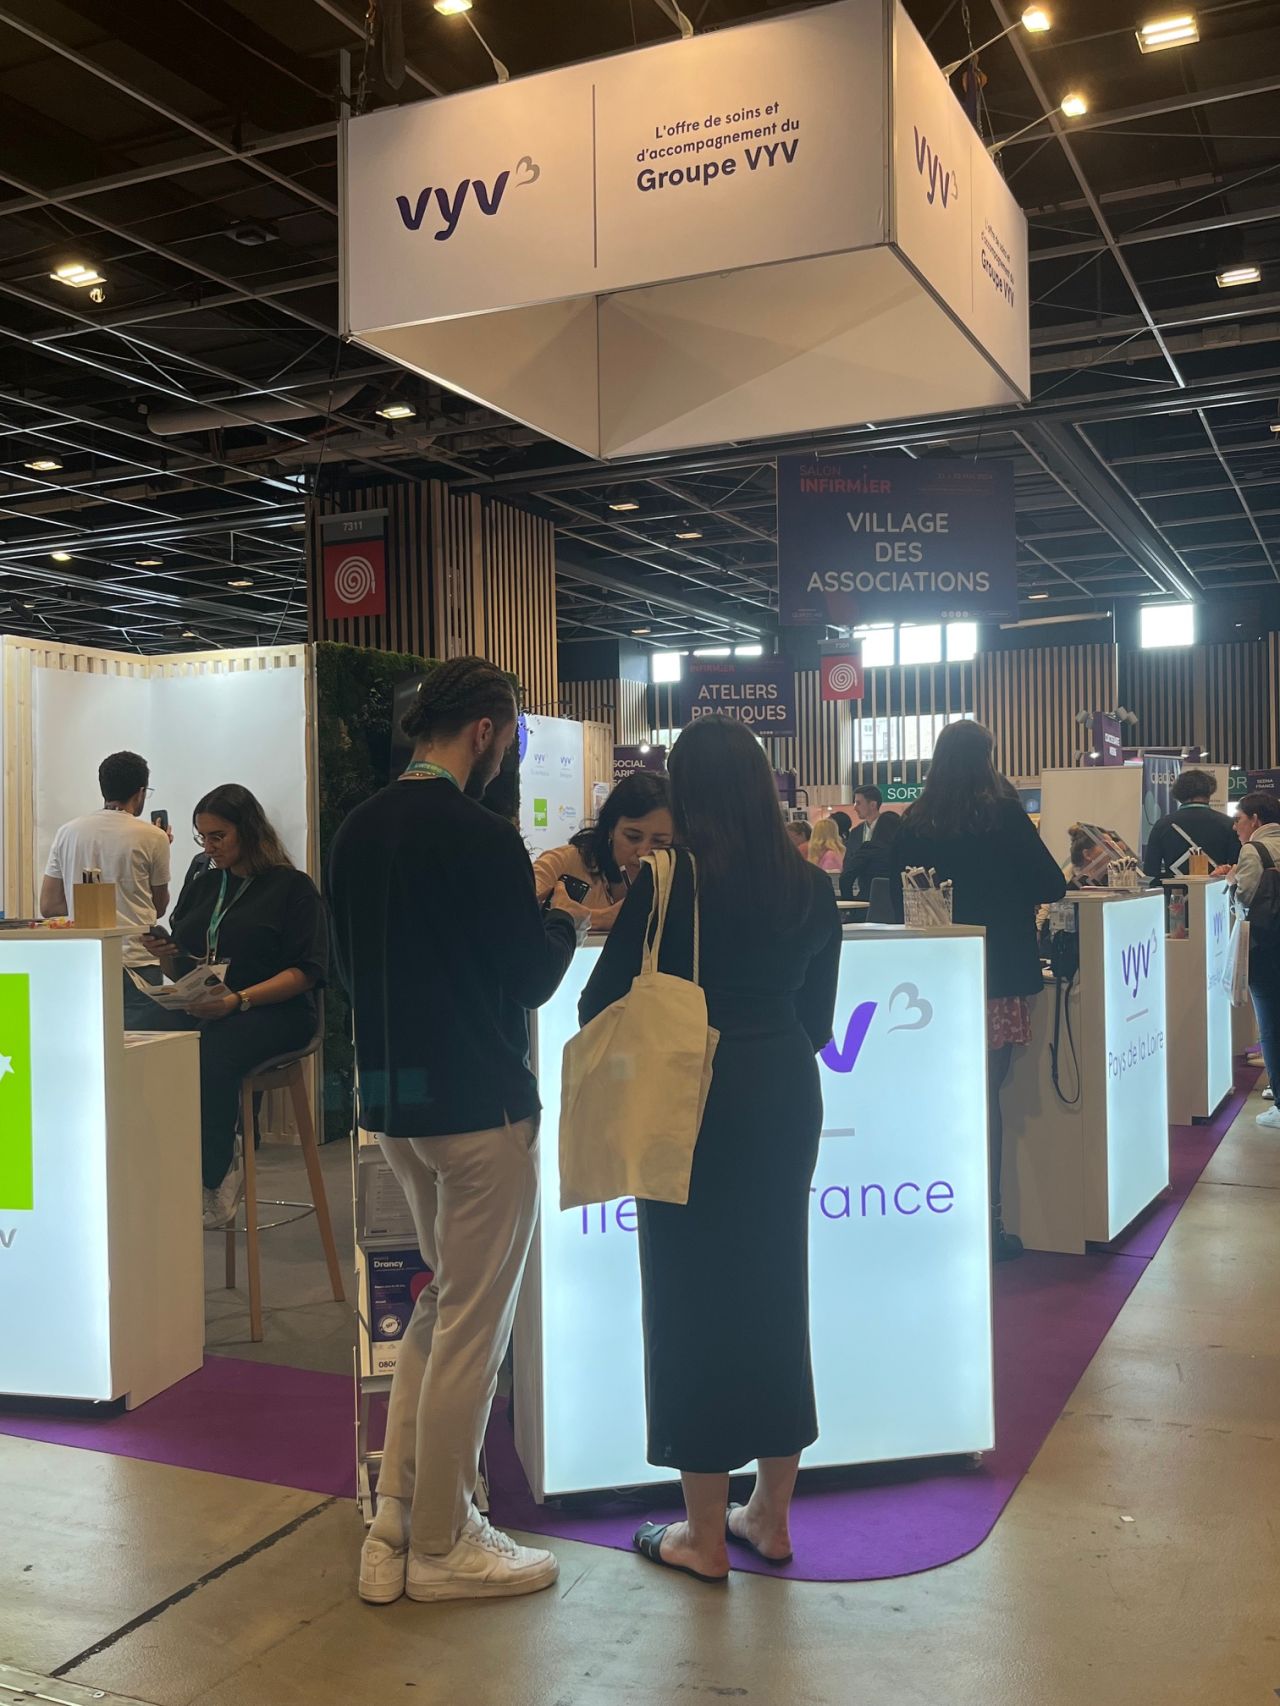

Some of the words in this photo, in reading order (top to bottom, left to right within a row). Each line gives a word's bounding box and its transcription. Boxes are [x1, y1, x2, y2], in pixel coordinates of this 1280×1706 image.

[655, 121, 700, 139] L'offre
[704, 115, 722, 129] de
[725, 108, 761, 124] soins
[765, 101, 780, 115] et
[636, 122, 777, 162] d'accompagnement
[781, 118, 799, 132] du
[637, 158, 736, 192] Groupe
[744, 138, 799, 170] VYV
[396, 170, 510, 241] vyv
[343, 520, 363, 531] 7311
[847, 513, 949, 533] VILLAGE
[875, 542, 923, 562] DES
[807, 571, 991, 592] ASSOCIATIONS
[698, 682, 778, 700] ATELIERS
[1108, 1050, 1127, 1081] Pays
[374, 1260, 403, 1269] Drancy
